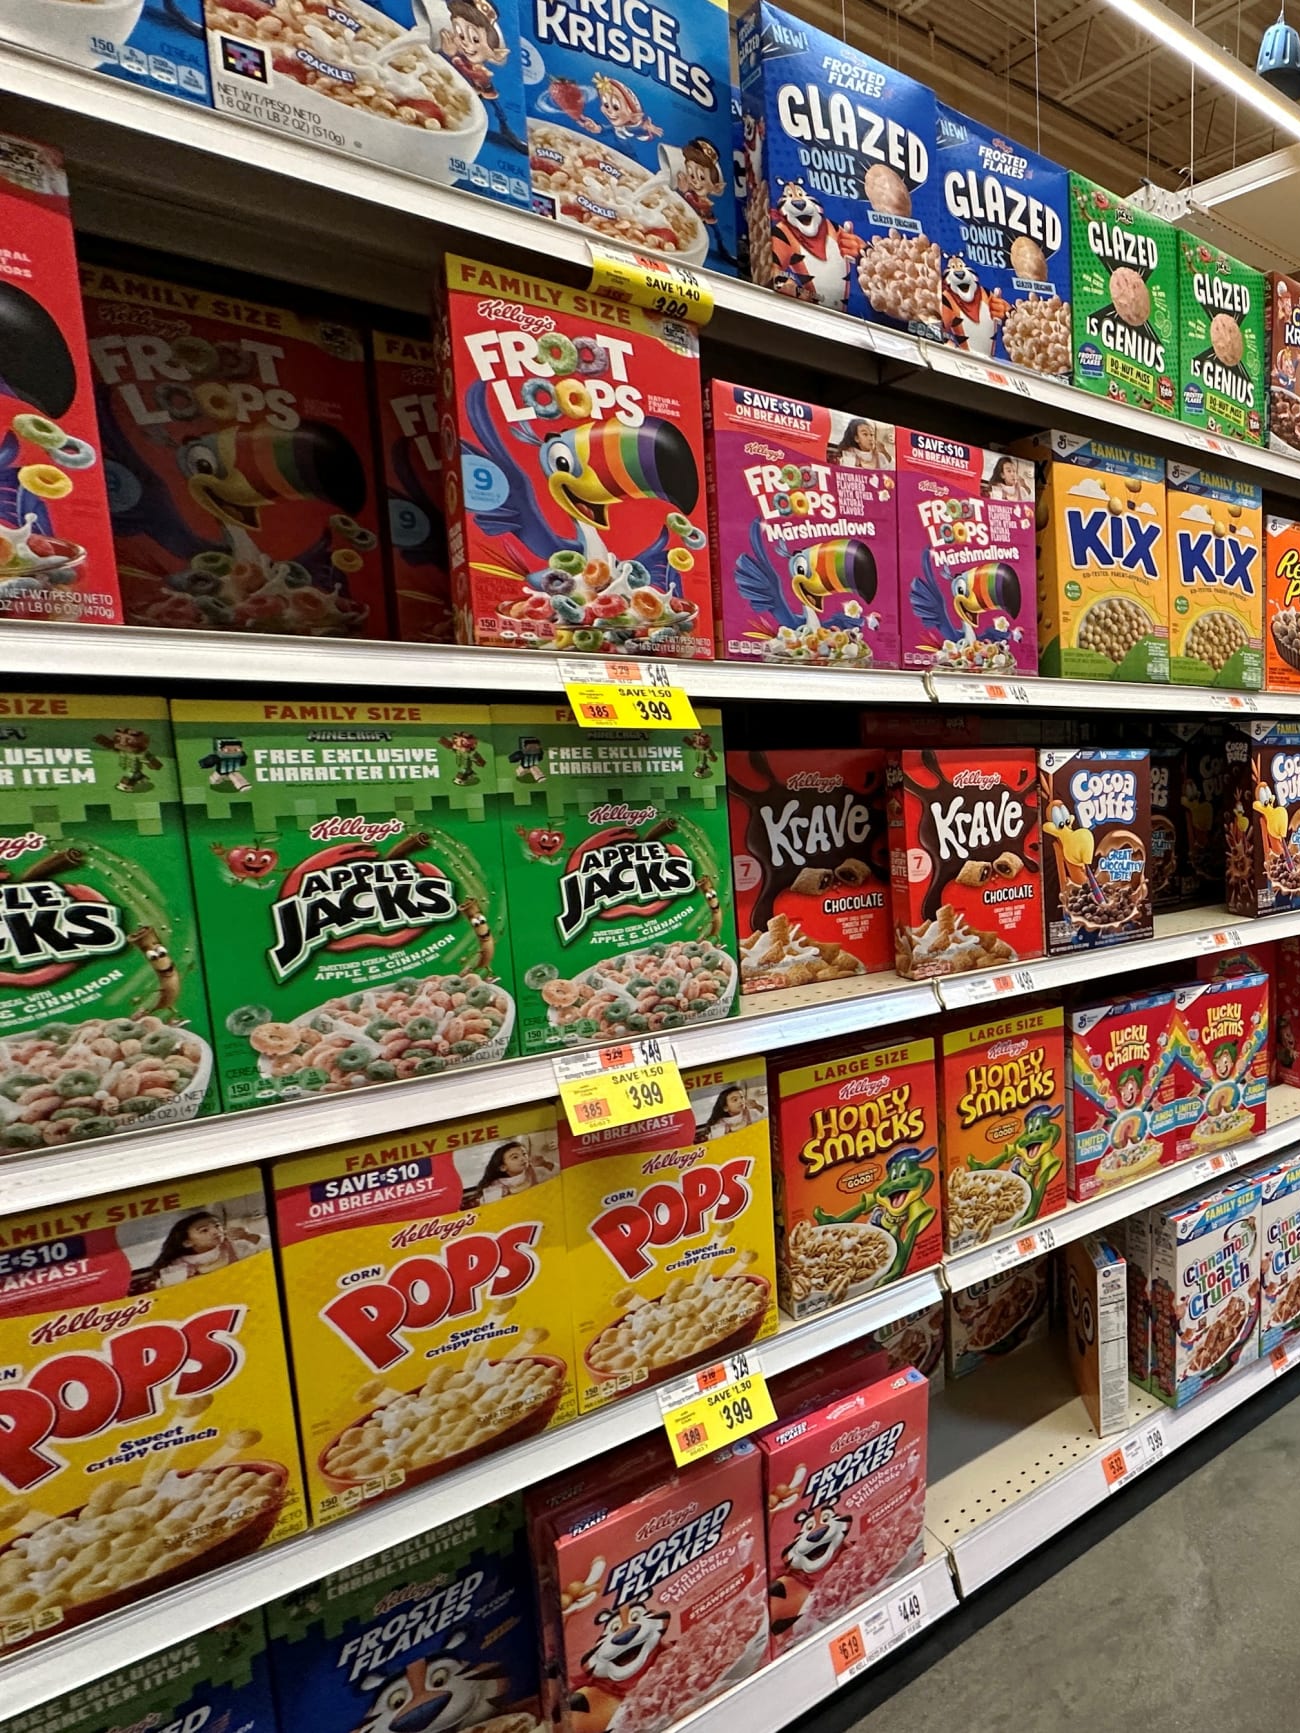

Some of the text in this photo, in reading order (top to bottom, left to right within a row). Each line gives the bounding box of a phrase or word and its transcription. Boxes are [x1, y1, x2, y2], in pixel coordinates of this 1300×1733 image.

[327, 9, 360, 32] POP!
[580, 0, 679, 53] RICE
[771, 23, 809, 52] NEW!
[296, 50, 354, 83] CRACKLE!
[538, 0, 715, 109] KRISPIES
[822, 56, 886, 88] FROSTED
[828, 72, 882, 99] FLAKES
[217, 82, 237, 97] NET
[293, 106, 321, 125] NETO
[220, 95, 234, 108] 18
[237, 99, 251, 112] OZ
[267, 109, 281, 123] LB
[282, 114, 289, 125] 2
[291, 116, 310, 133] OZ)
[312, 125, 346, 146] (510g)
[776, 85, 929, 184] GLAZED
[801, 148, 856, 180] DONUT
[808, 169, 860, 202] HOLES
[944, 169, 1062, 253] GLAZED
[1088, 222, 1158, 270] GLAZED
[460, 264, 564, 310] FAMILY
[573, 296, 633, 326] SIZE
[645, 275, 673, 293] SAVE
[1193, 274, 1250, 315] GLAZED
[477, 300, 555, 333] Kellogg's
[1086, 317, 1099, 337] IS
[464, 330, 634, 384] FROOT
[1101, 322, 1166, 373] GENIUS
[1191, 359, 1201, 376] IS
[1203, 361, 1255, 408] GENIUS
[492, 379, 645, 428] LOOPS
[736, 405, 752, 417] ON
[754, 409, 811, 432] BREAKFAST
[743, 391, 804, 418] SAVE $10
[743, 464, 831, 496] FROOT
[757, 490, 836, 520] LOOPS
[765, 517, 876, 543] Marshmallows
[618, 688, 672, 698] SAVE $1.50
[255, 747, 437, 764] FREE EXCLUSIVE
[255, 765, 440, 782] CHARACTER ITEM
[787, 772, 843, 791] Kellogg's
[311, 816, 403, 842] Kellogg's
[582, 842, 663, 872] APPLE
[303, 858, 418, 900] APPLE
[558, 860, 694, 944] JACKS
[823, 893, 884, 914] CHOCOLATE
[268, 880, 457, 984] JACKS
[611, 1066, 664, 1085] SAVE $1.50
[814, 1048, 910, 1083] LARGE SIZE
[812, 1085, 911, 1130] HONEY
[800, 1106, 925, 1178] SMACKS
[392, 1213, 478, 1247] Kellogg's
[590, 1157, 755, 1283] POPS
[1183, 1231, 1251, 1287] Cinnamon
[1199, 1250, 1241, 1294] Toast
[320, 1224, 540, 1371] POPS
[1188, 1261, 1251, 1322] Crunch
[450, 1321, 496, 1342] Sweet
[608, 1499, 733, 1588] FROSTED
[617, 1525, 721, 1610] FLAKES
[659, 1543, 738, 1605] Strawberry
[672, 1557, 730, 1605] Milkshake
[899, 1594, 920, 1622] $4.49
[839, 1636, 859, 1659] $6.19
